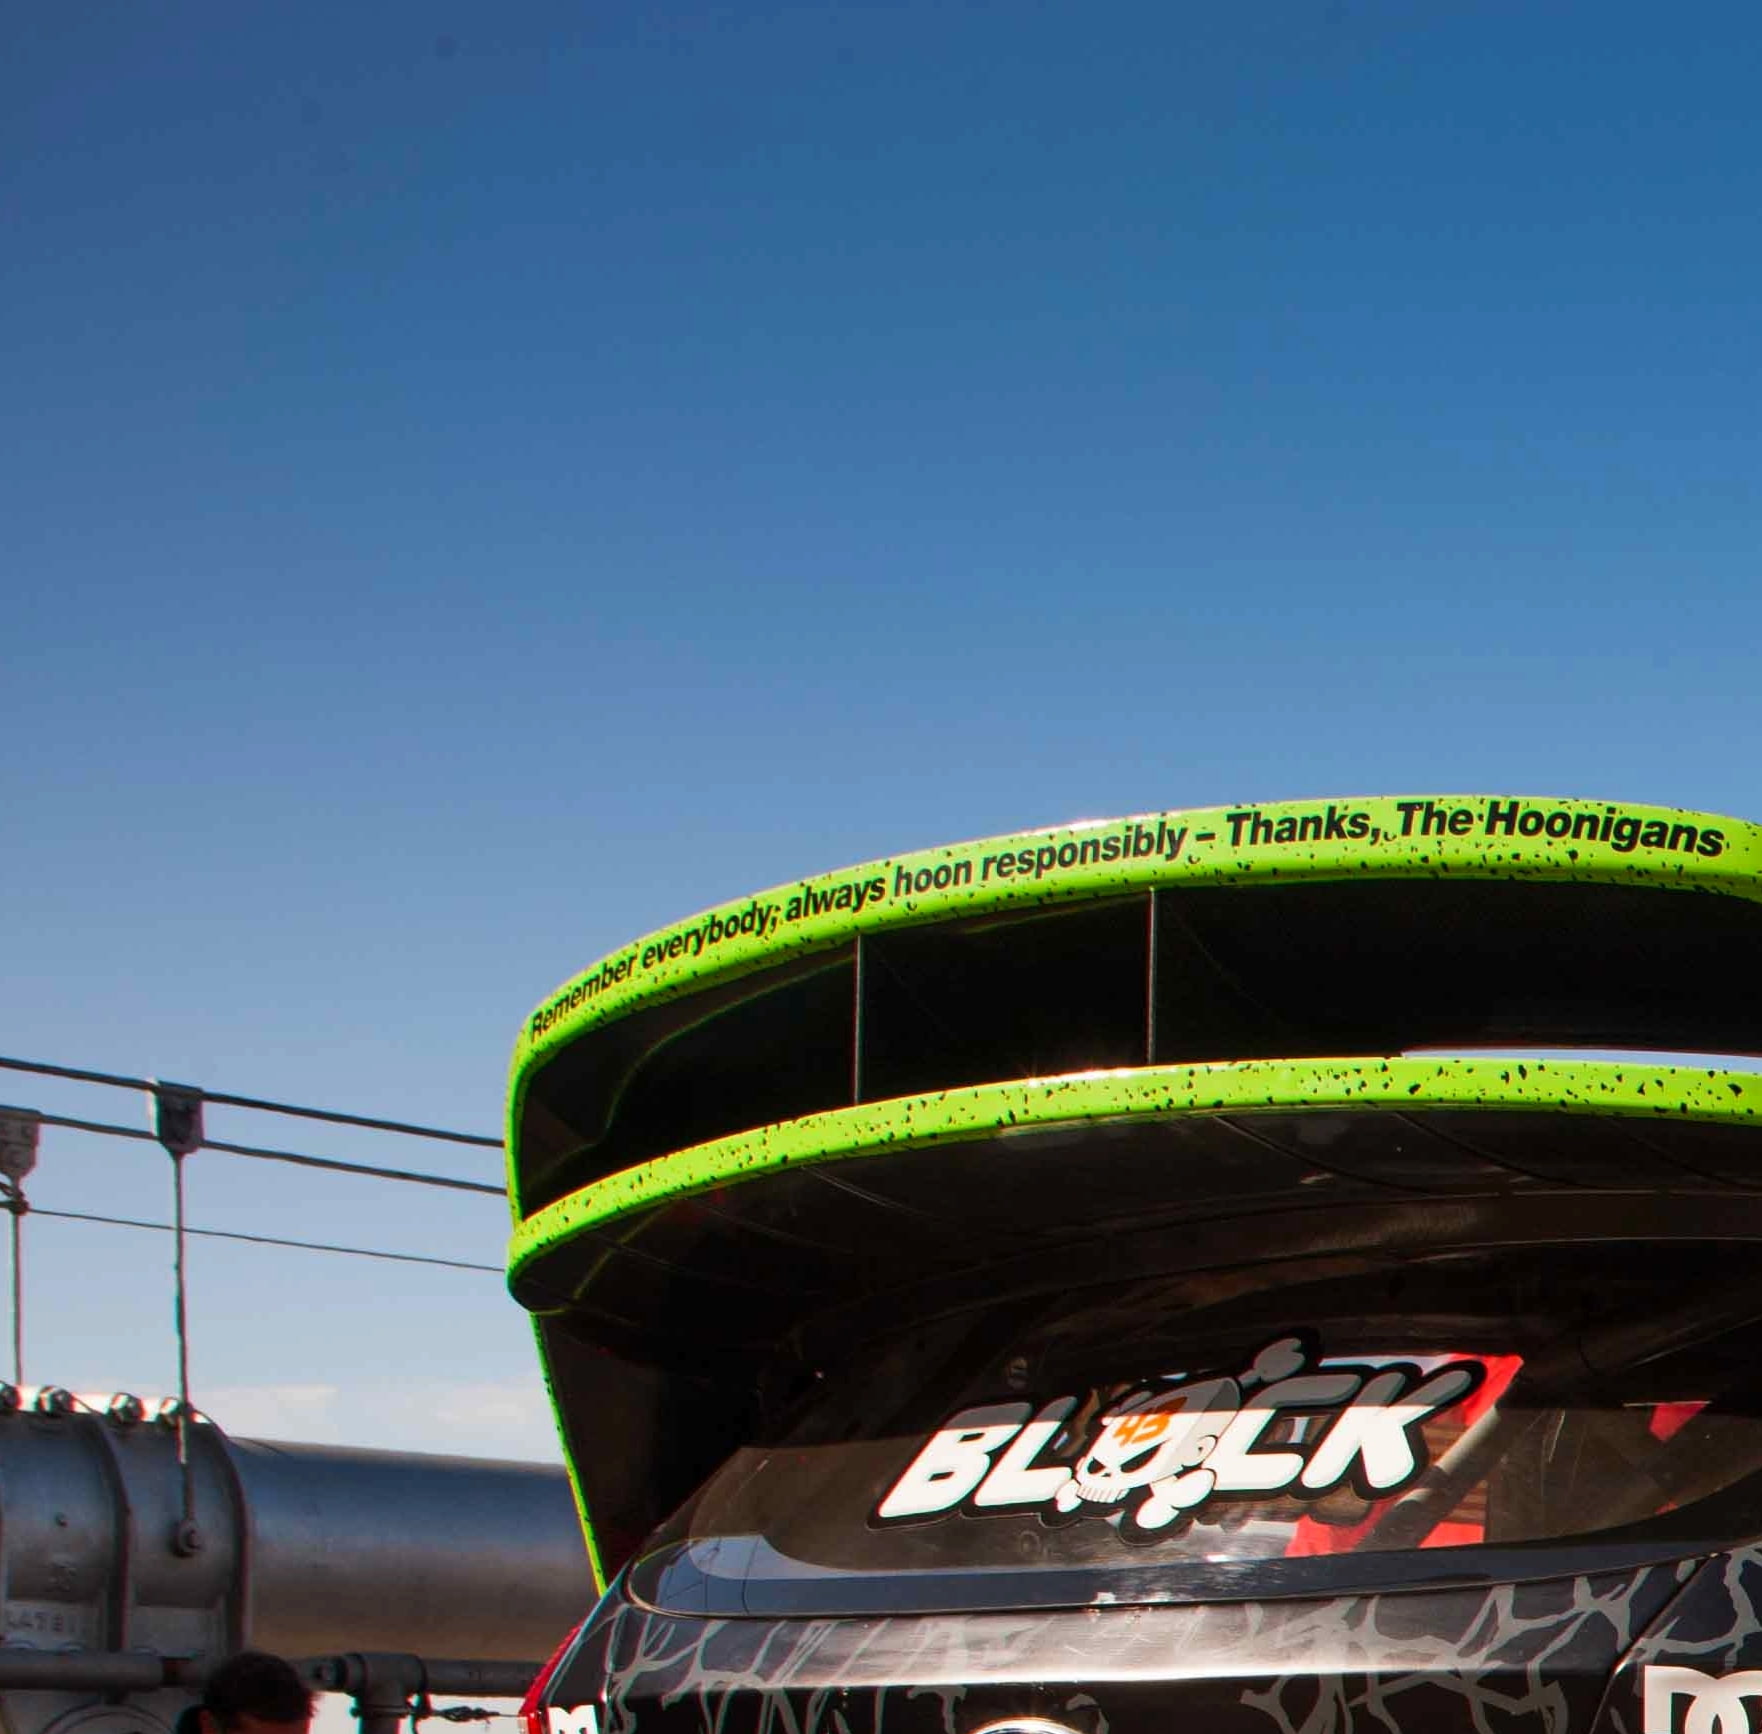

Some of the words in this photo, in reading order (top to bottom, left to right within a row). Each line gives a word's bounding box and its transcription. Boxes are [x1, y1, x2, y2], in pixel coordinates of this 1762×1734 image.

[530, 956, 637, 1043] Remember
[785, 873, 886, 924] always
[893, 855, 973, 899] hoon
[981, 820, 1188, 881] responsibly
[1226, 805, 1384, 848] Thanks,
[1396, 801, 1484, 838] The
[1484, 800, 1725, 857] Hoonigans
[1112, 1396, 1188, 1447] 43
